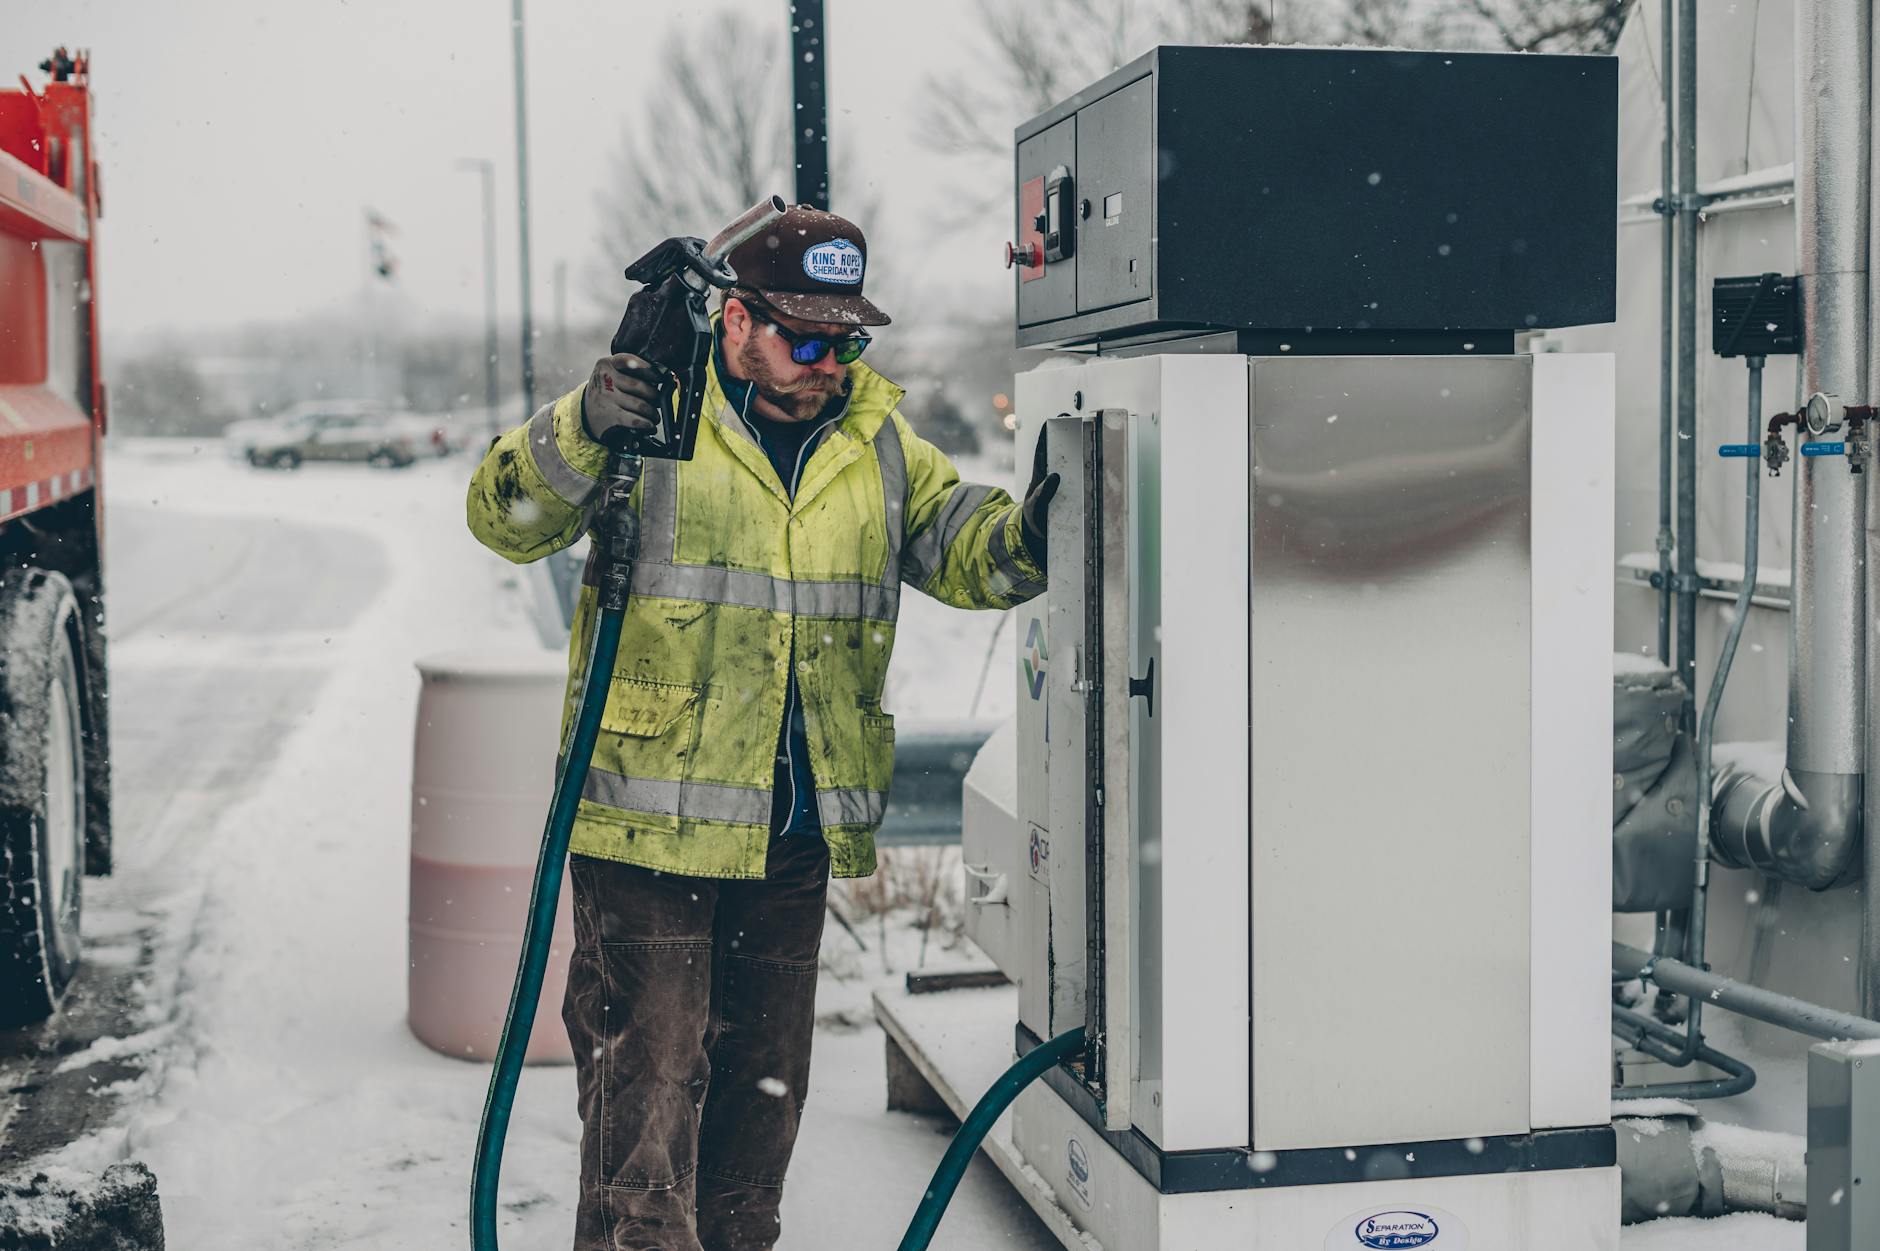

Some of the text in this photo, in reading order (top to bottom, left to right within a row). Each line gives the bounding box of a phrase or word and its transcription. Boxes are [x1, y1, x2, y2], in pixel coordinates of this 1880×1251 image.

[812, 253, 861, 267] KING ROPES
[1366, 1219, 1424, 1233] SEPARATION
[1378, 1236, 1423, 1246] By Design
